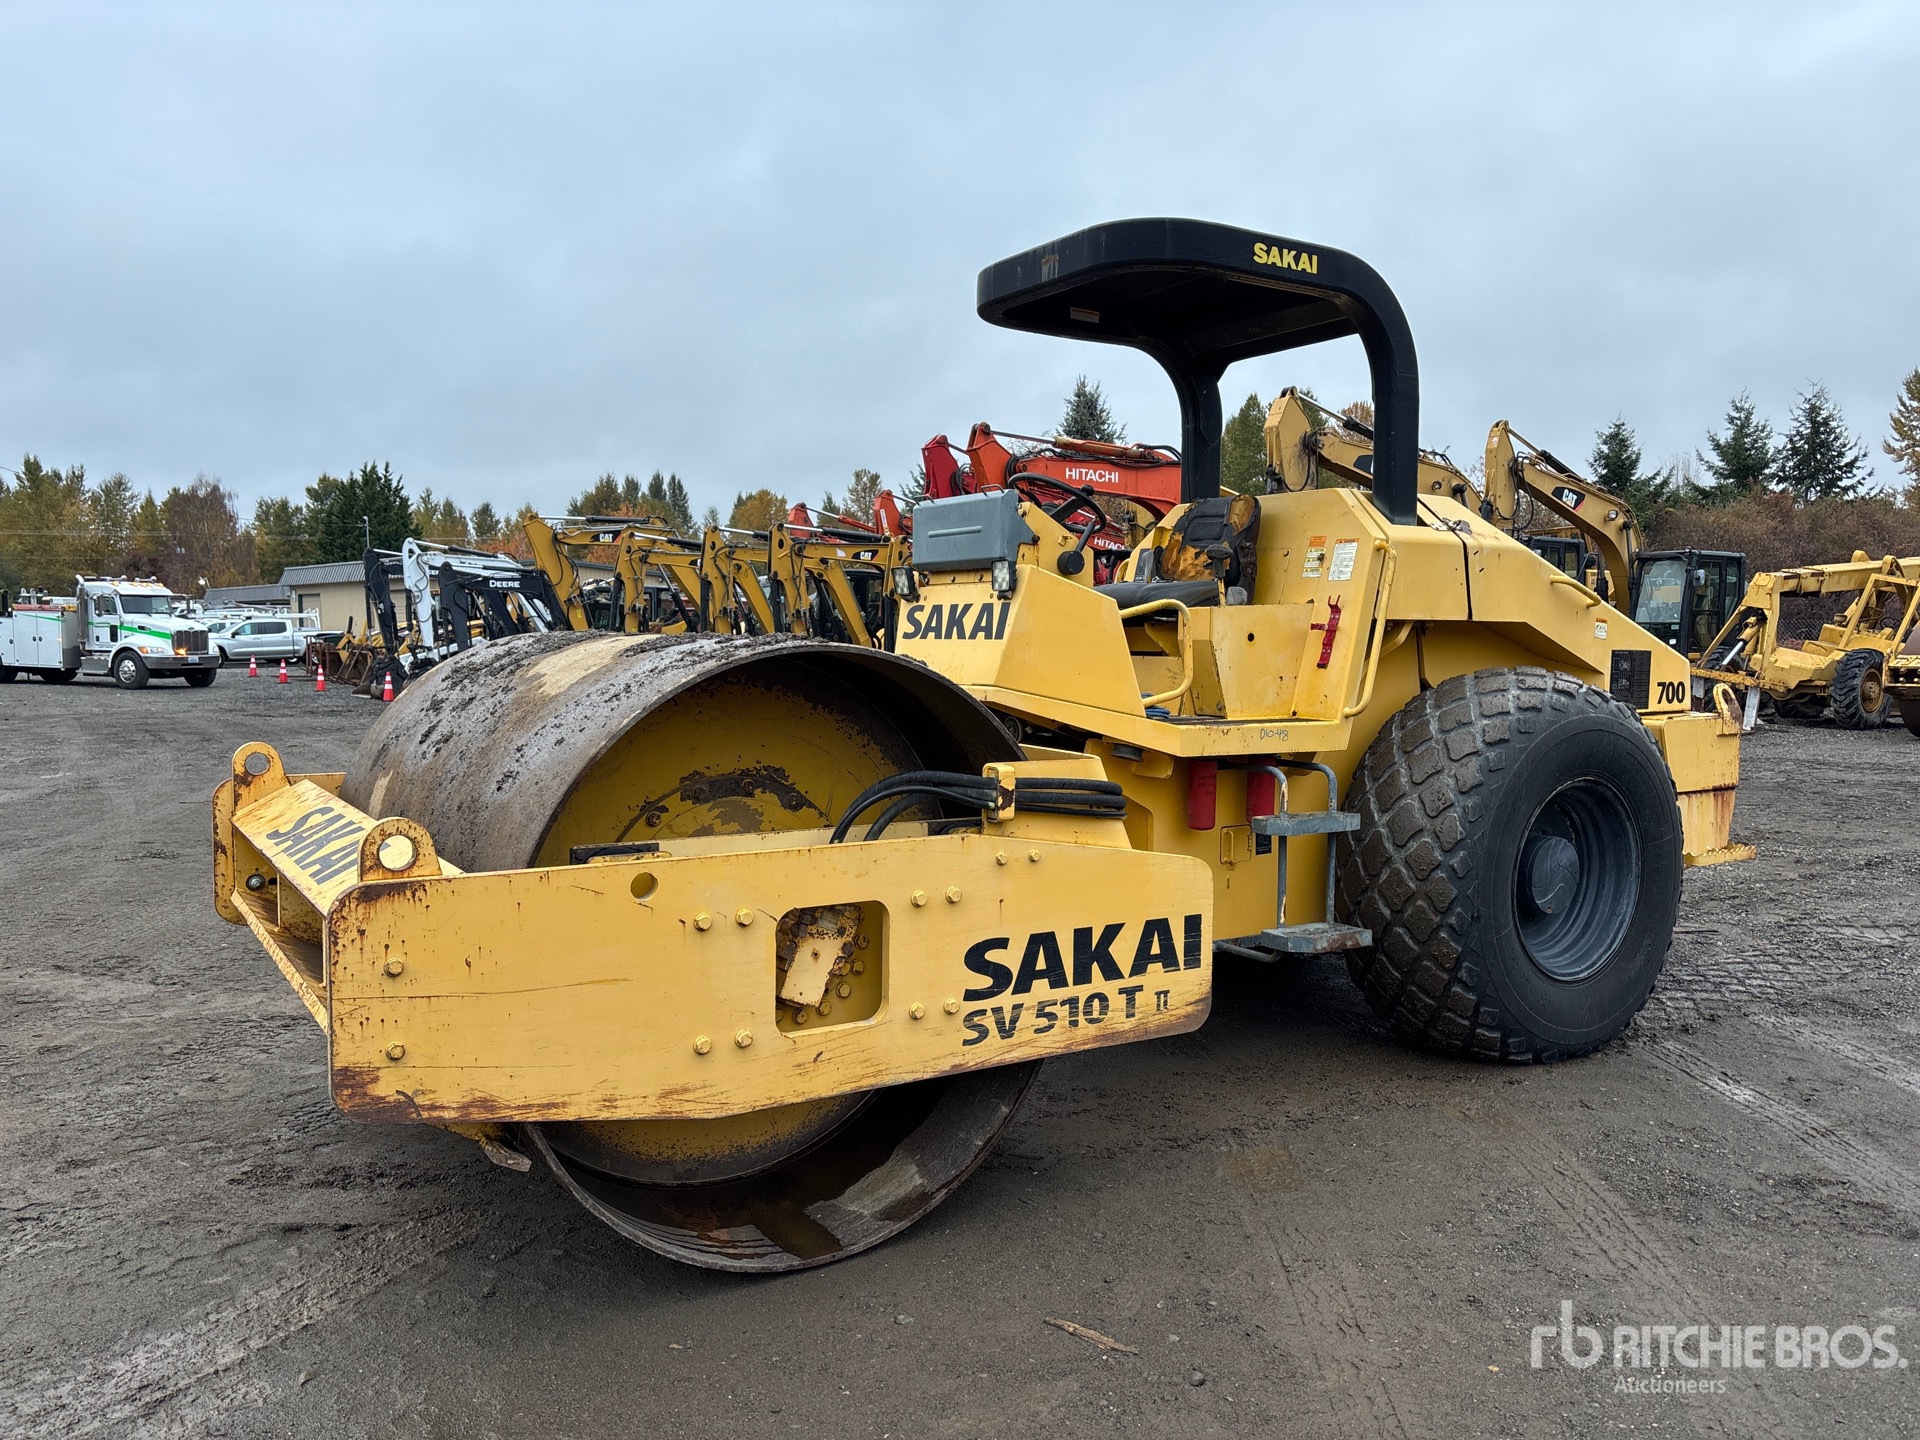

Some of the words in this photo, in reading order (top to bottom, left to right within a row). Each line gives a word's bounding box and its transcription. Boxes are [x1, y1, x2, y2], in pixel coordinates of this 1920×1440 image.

[1253, 242, 1318, 274] SAKAI
[1065, 467, 1119, 483] HITACHI
[1562, 488, 1578, 508] CAT
[599, 533, 613, 543] CAT
[860, 551, 872, 561] CAT
[489, 579, 521, 588] DEERE
[901, 602, 1012, 640] SAKAI
[1656, 681, 1686, 704] 700
[265, 806, 391, 886] SAKAI
[962, 913, 1203, 1002] SAKAI
